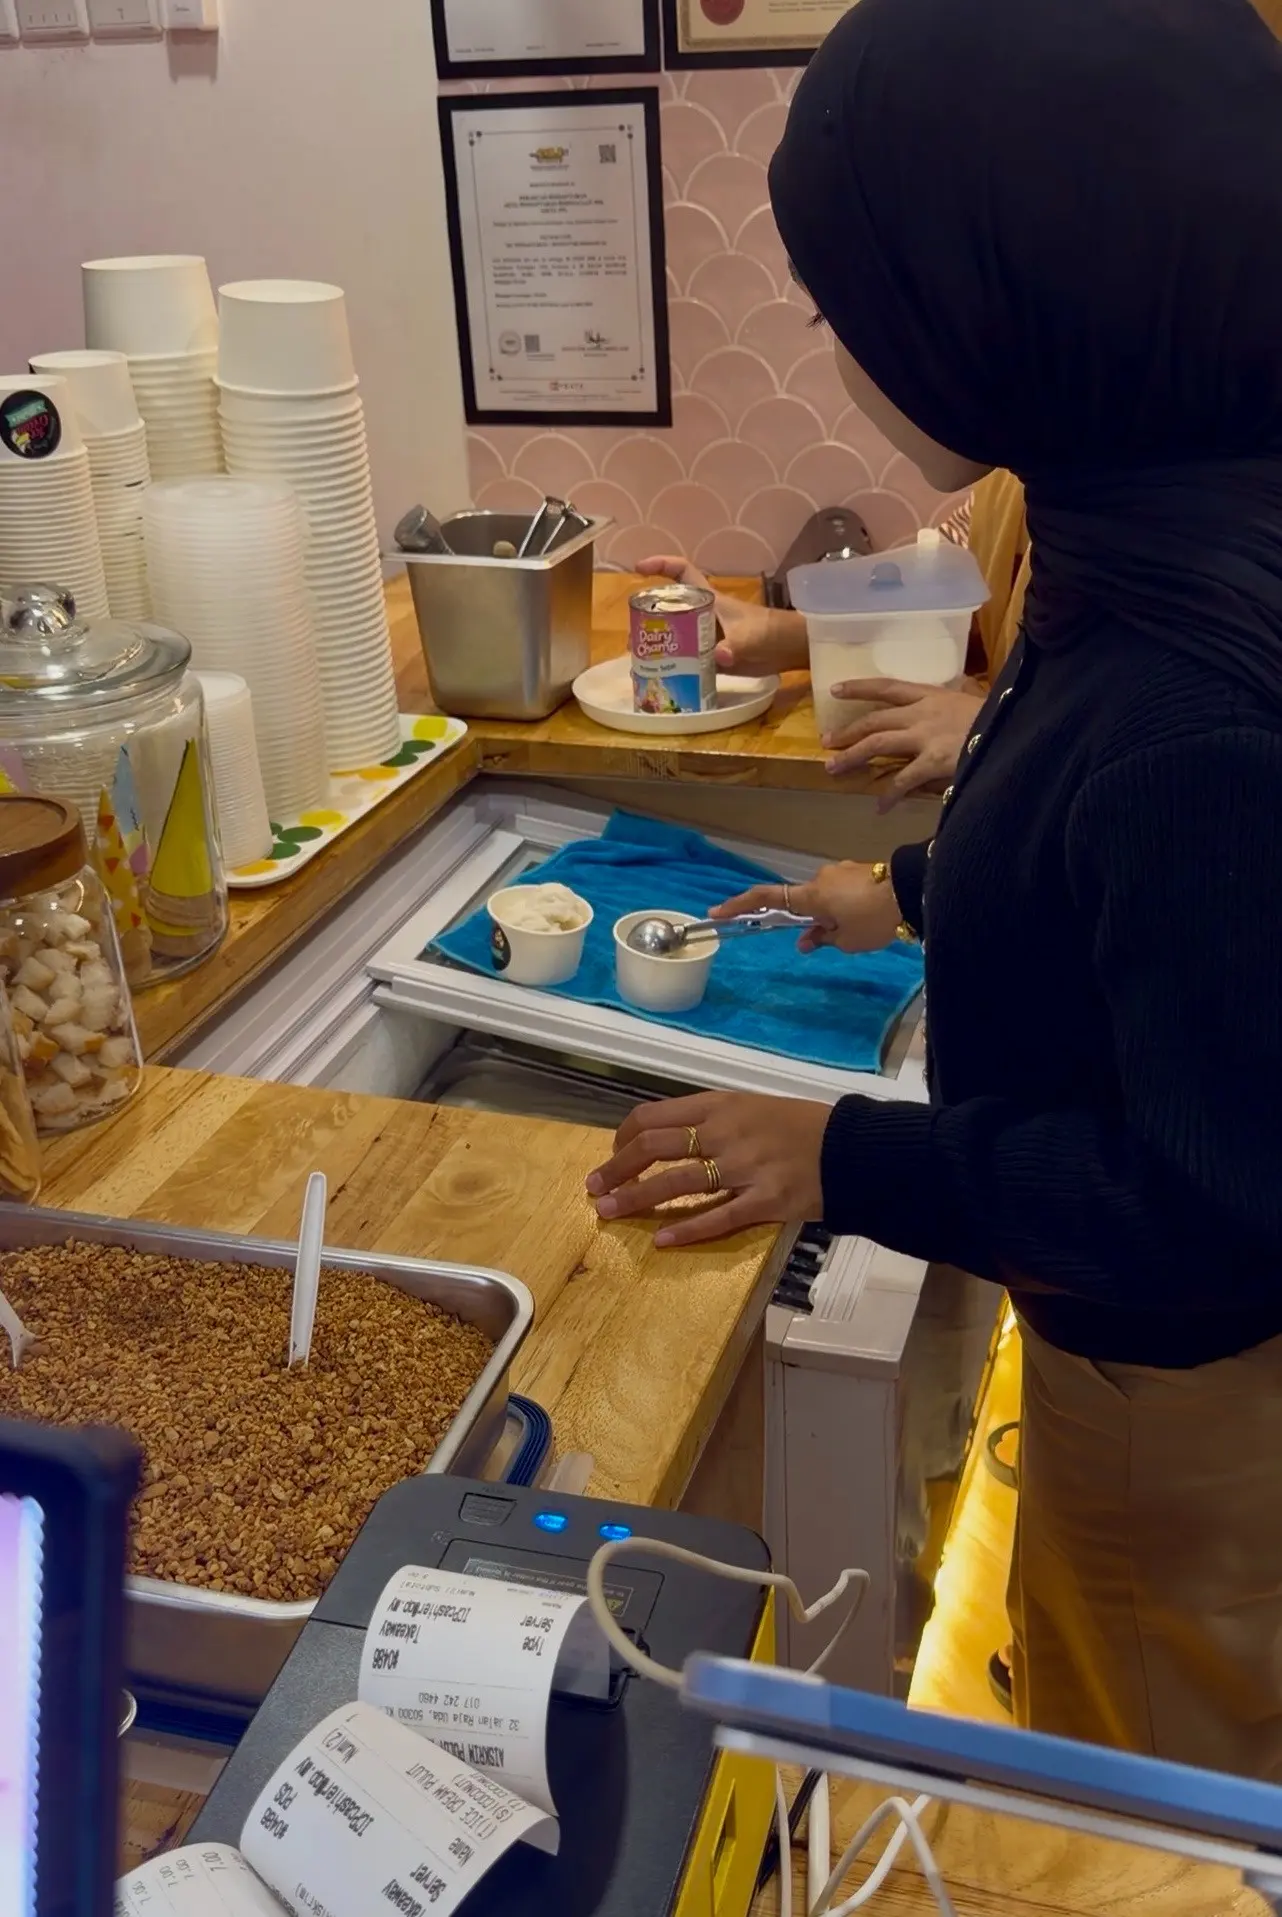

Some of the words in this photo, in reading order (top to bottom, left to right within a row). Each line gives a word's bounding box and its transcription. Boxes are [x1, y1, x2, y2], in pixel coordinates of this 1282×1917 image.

[637, 641, 679, 656] Champ
[639, 630, 672, 645] Dairy
[379, 1619, 421, 1645] Takeaway
[519, 1614, 554, 1633] Server
[522, 1635, 546, 1657] Type
[464, 1696, 480, 1710] 017
[452, 1712, 474, 1729] Raja
[508, 1718, 520, 1732] 32
[468, 1742, 505, 1768] AISKRIM
[404, 1762, 441, 1795] PULUT
[433, 1784, 466, 1814] CREAM
[448, 1837, 476, 1869] Name
[409, 1862, 448, 1904] Server
[294, 1882, 338, 1917] iskrim)
